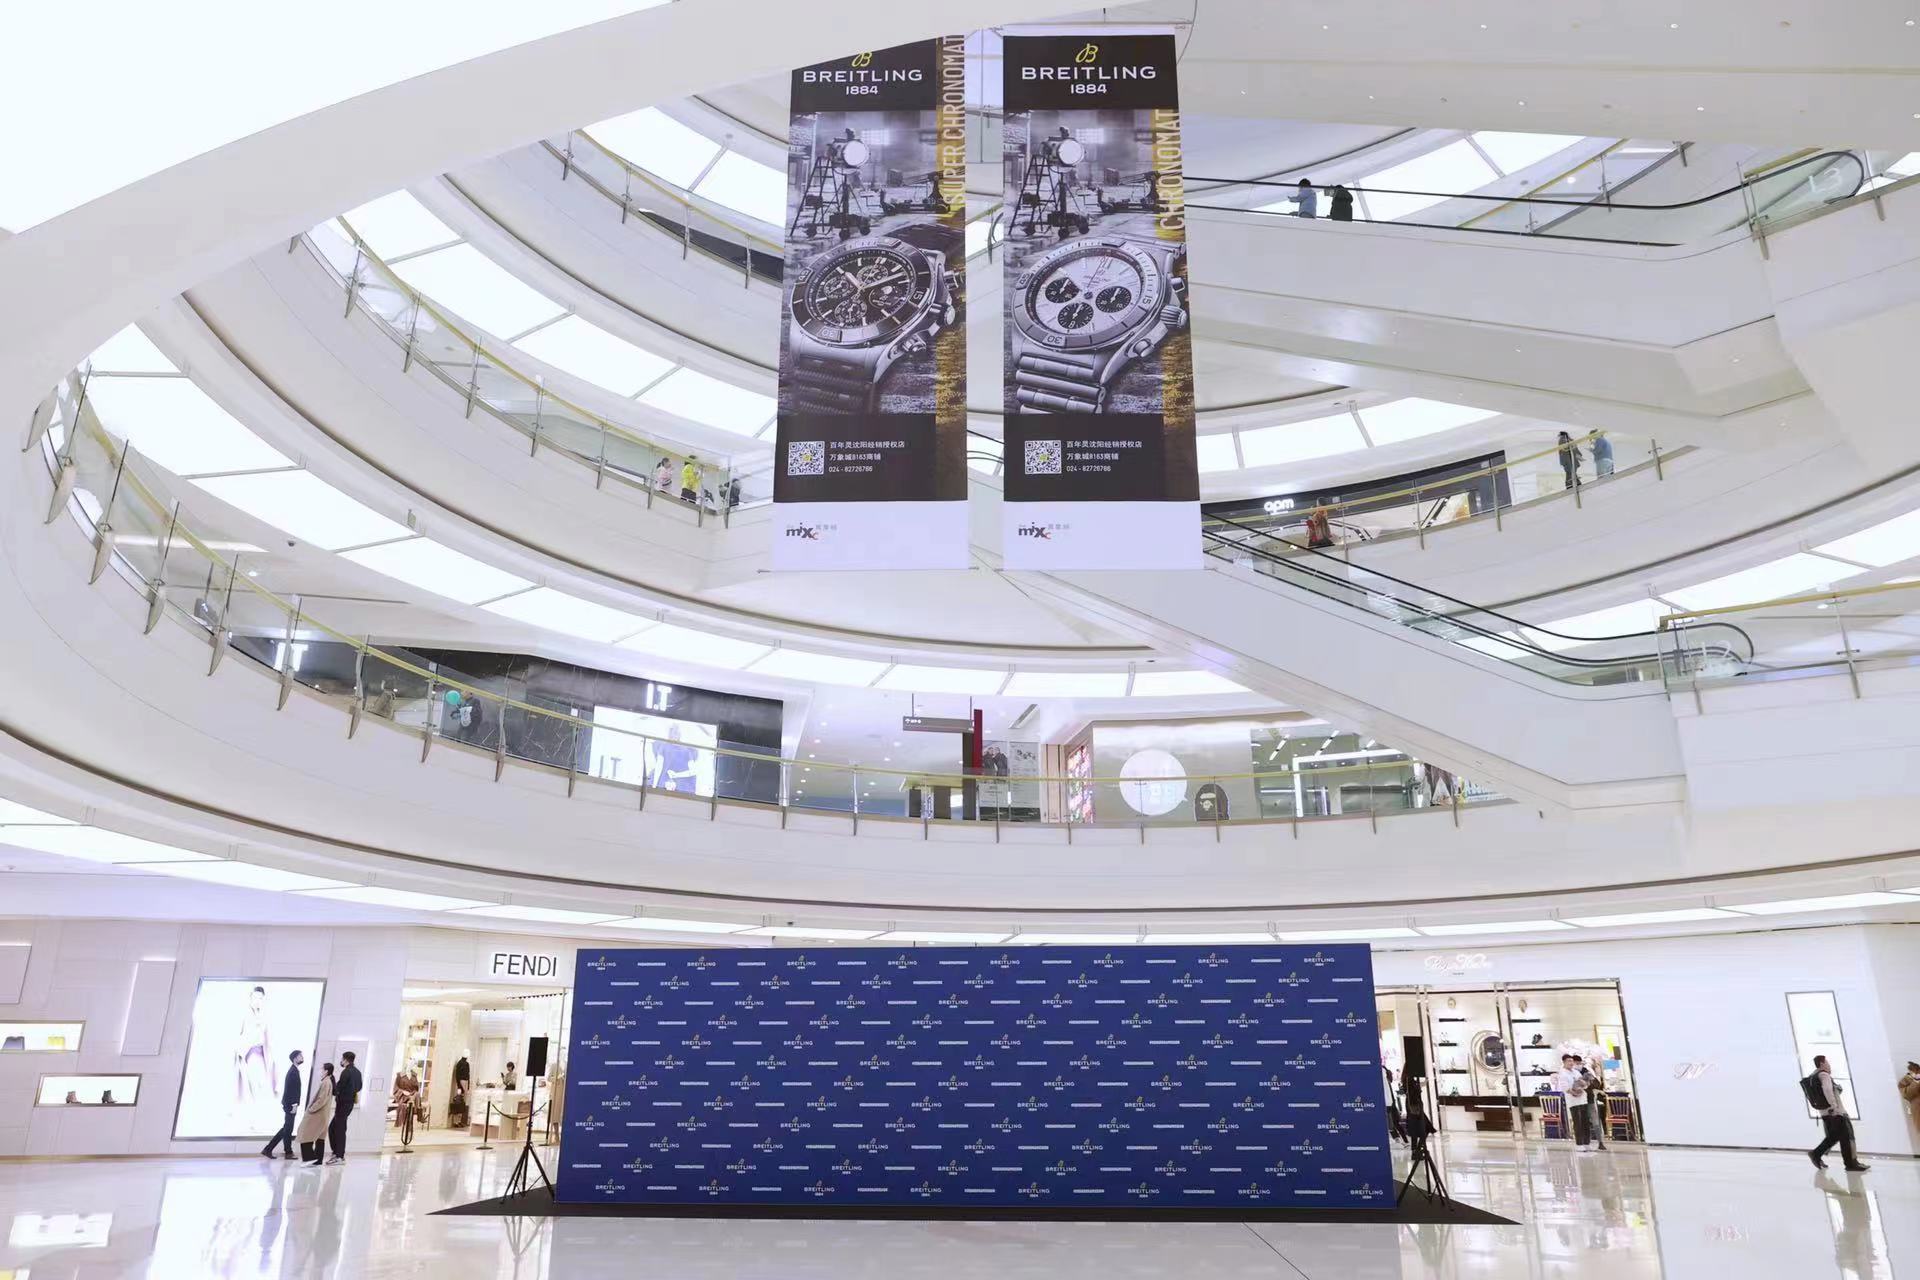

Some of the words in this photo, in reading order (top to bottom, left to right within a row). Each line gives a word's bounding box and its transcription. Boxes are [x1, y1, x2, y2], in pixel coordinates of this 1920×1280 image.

[803, 69, 923, 83] BREITLING
[1021, 66, 1156, 80] BREITLING
[846, 85, 878, 95] 1884
[1070, 84, 1107, 94] 1884
[942, 144, 965, 204] SUPER
[1155, 109, 1185, 230] CHRONOMAT
[646, 682, 673, 712] I.T
[493, 953, 557, 976] FENDI
[786, 960, 817, 968] BREITLING
[1278, 977, 1310, 985] BREITLING
